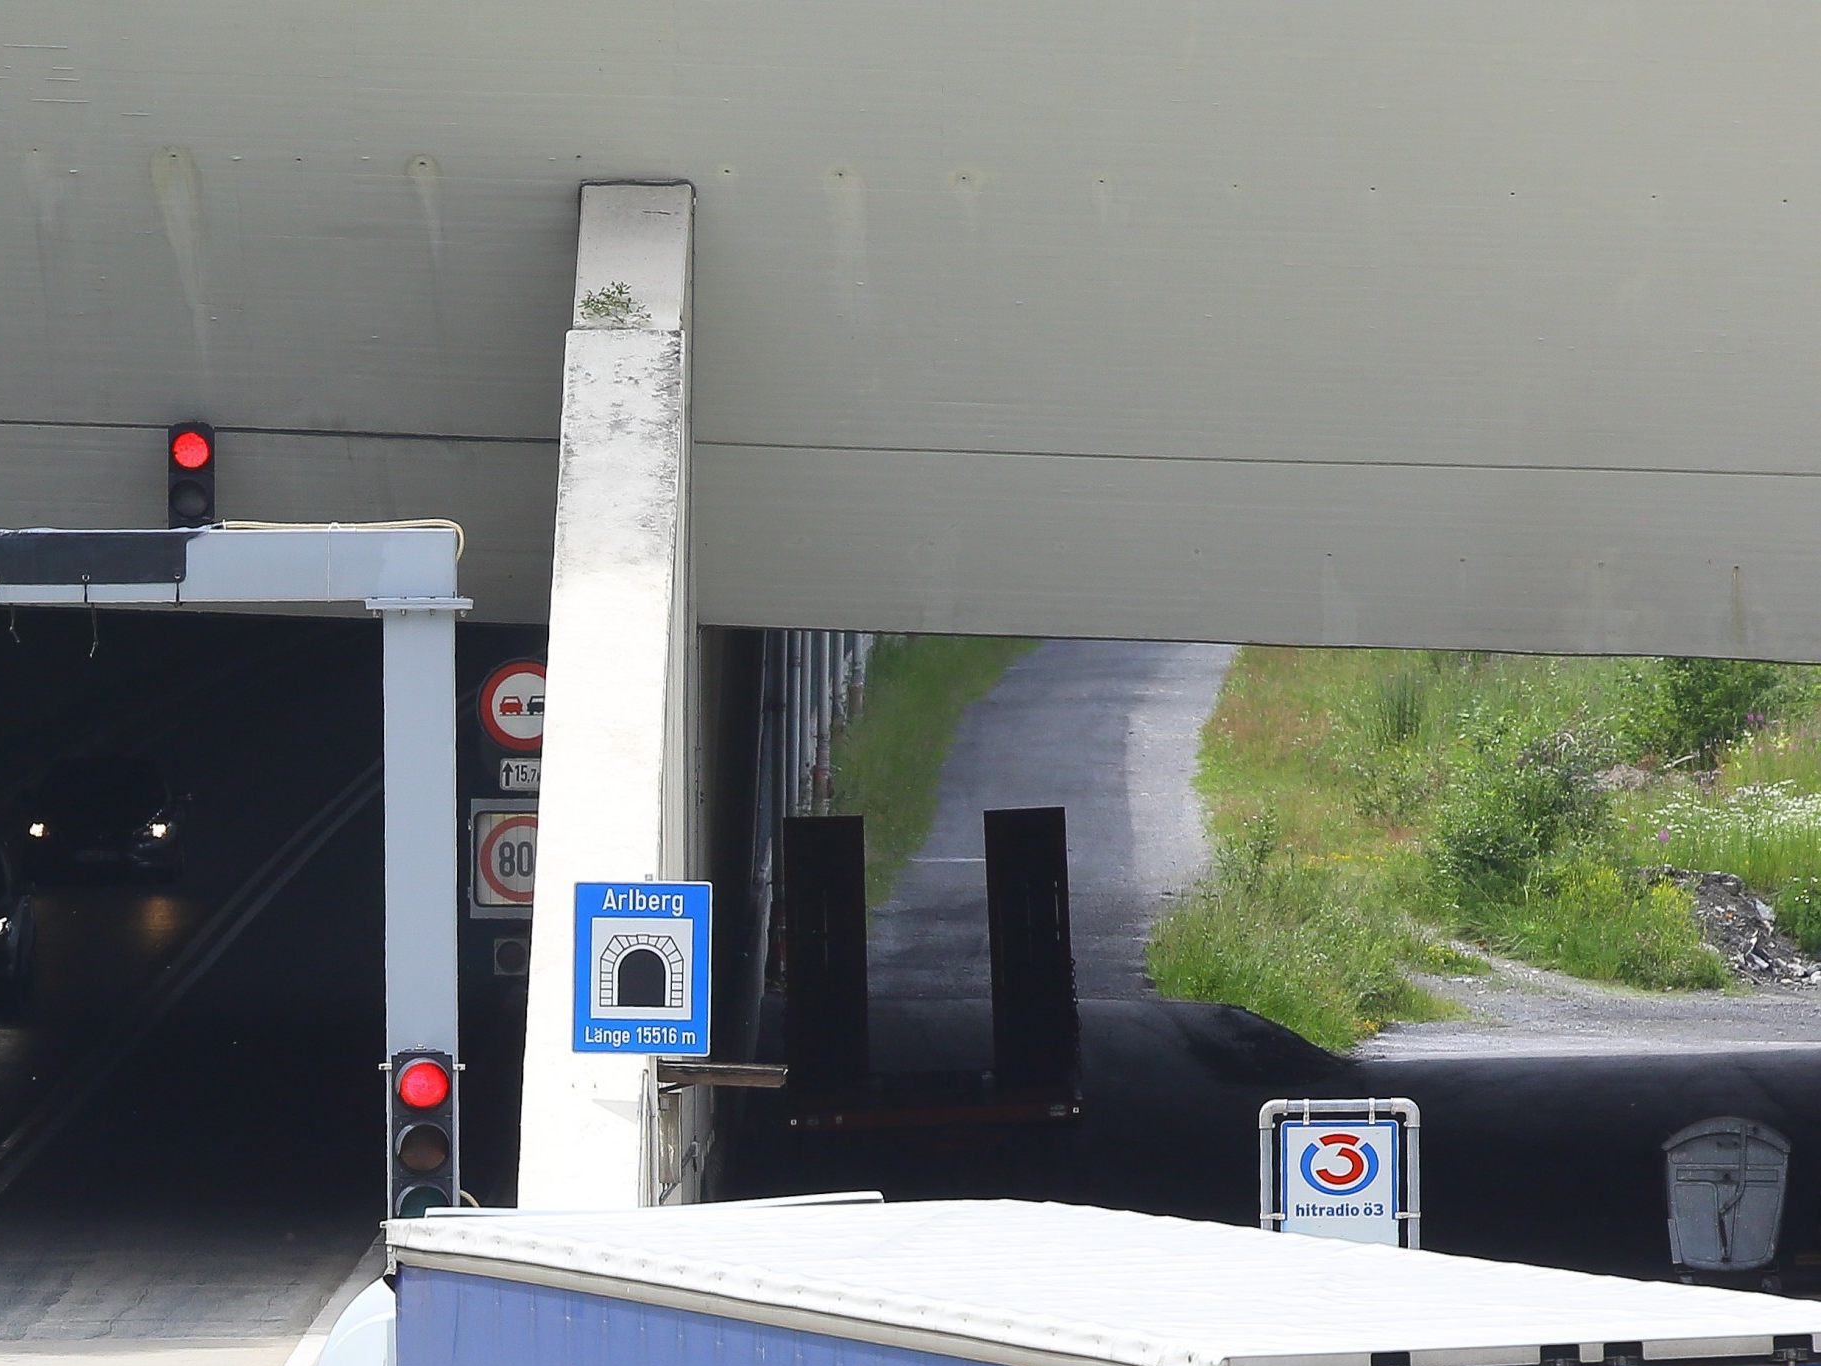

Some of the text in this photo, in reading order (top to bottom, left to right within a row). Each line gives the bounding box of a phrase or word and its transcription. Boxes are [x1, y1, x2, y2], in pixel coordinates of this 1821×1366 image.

[498, 841, 534, 878] 80
[602, 888, 684, 917] Arlberg
[584, 1026, 696, 1048] Länge 15516 m
[1295, 1202, 1384, 1217] hitradio ö3
